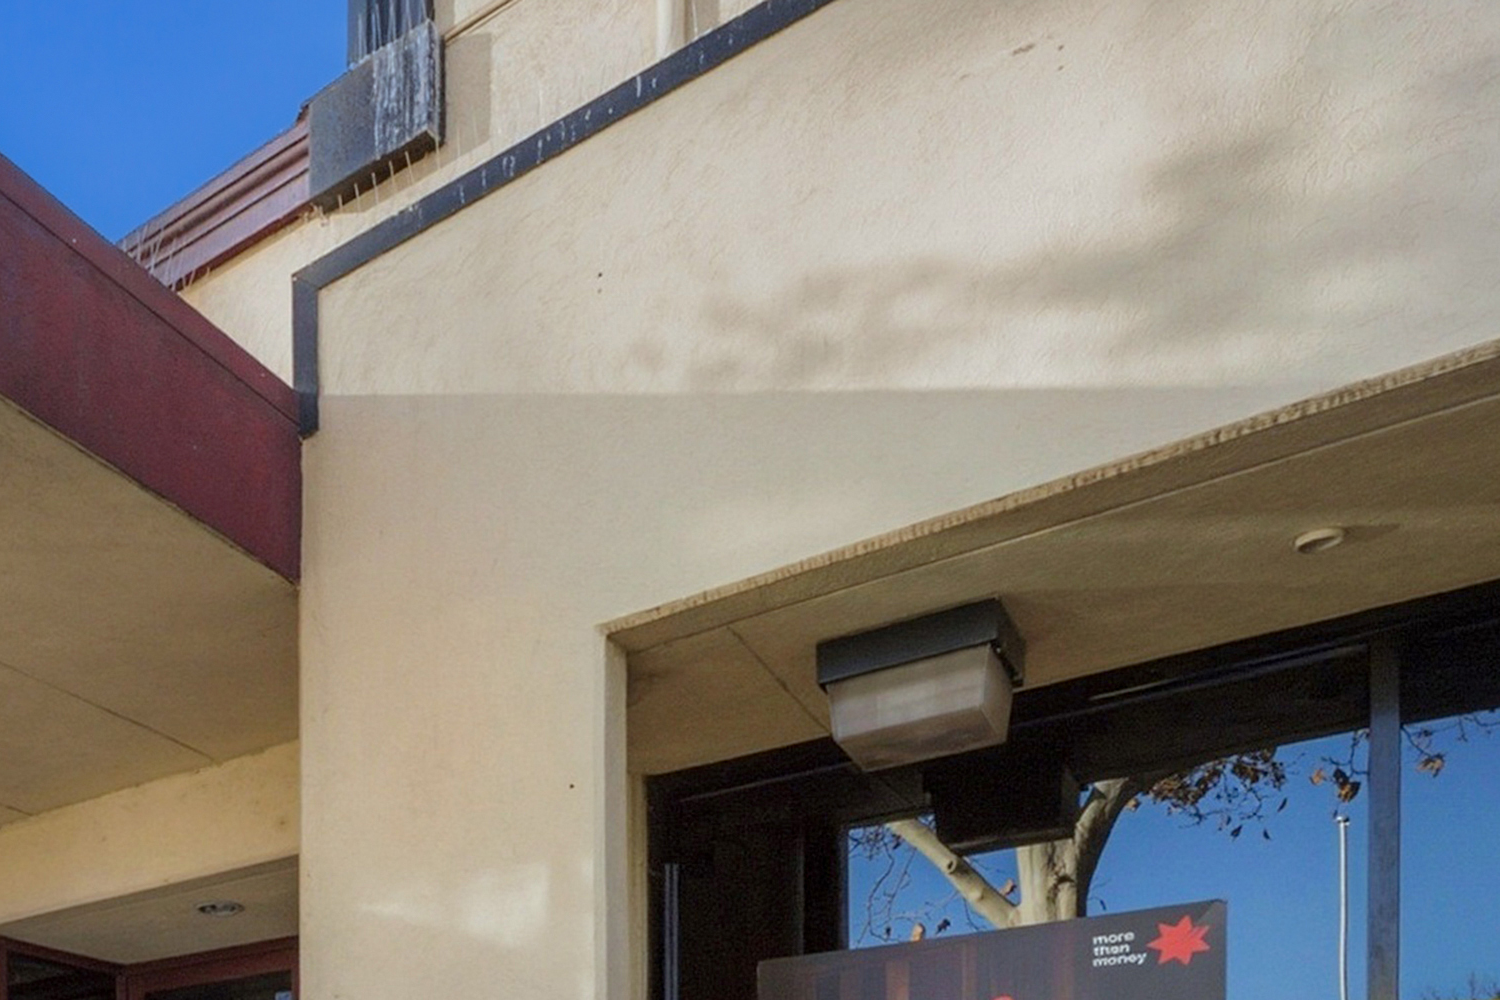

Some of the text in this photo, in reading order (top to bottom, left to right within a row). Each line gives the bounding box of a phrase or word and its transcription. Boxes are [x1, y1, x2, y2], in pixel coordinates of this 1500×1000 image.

[1093, 931, 1135, 945] more
[1093, 943, 1131, 957] than
[1093, 952, 1148, 967] money
